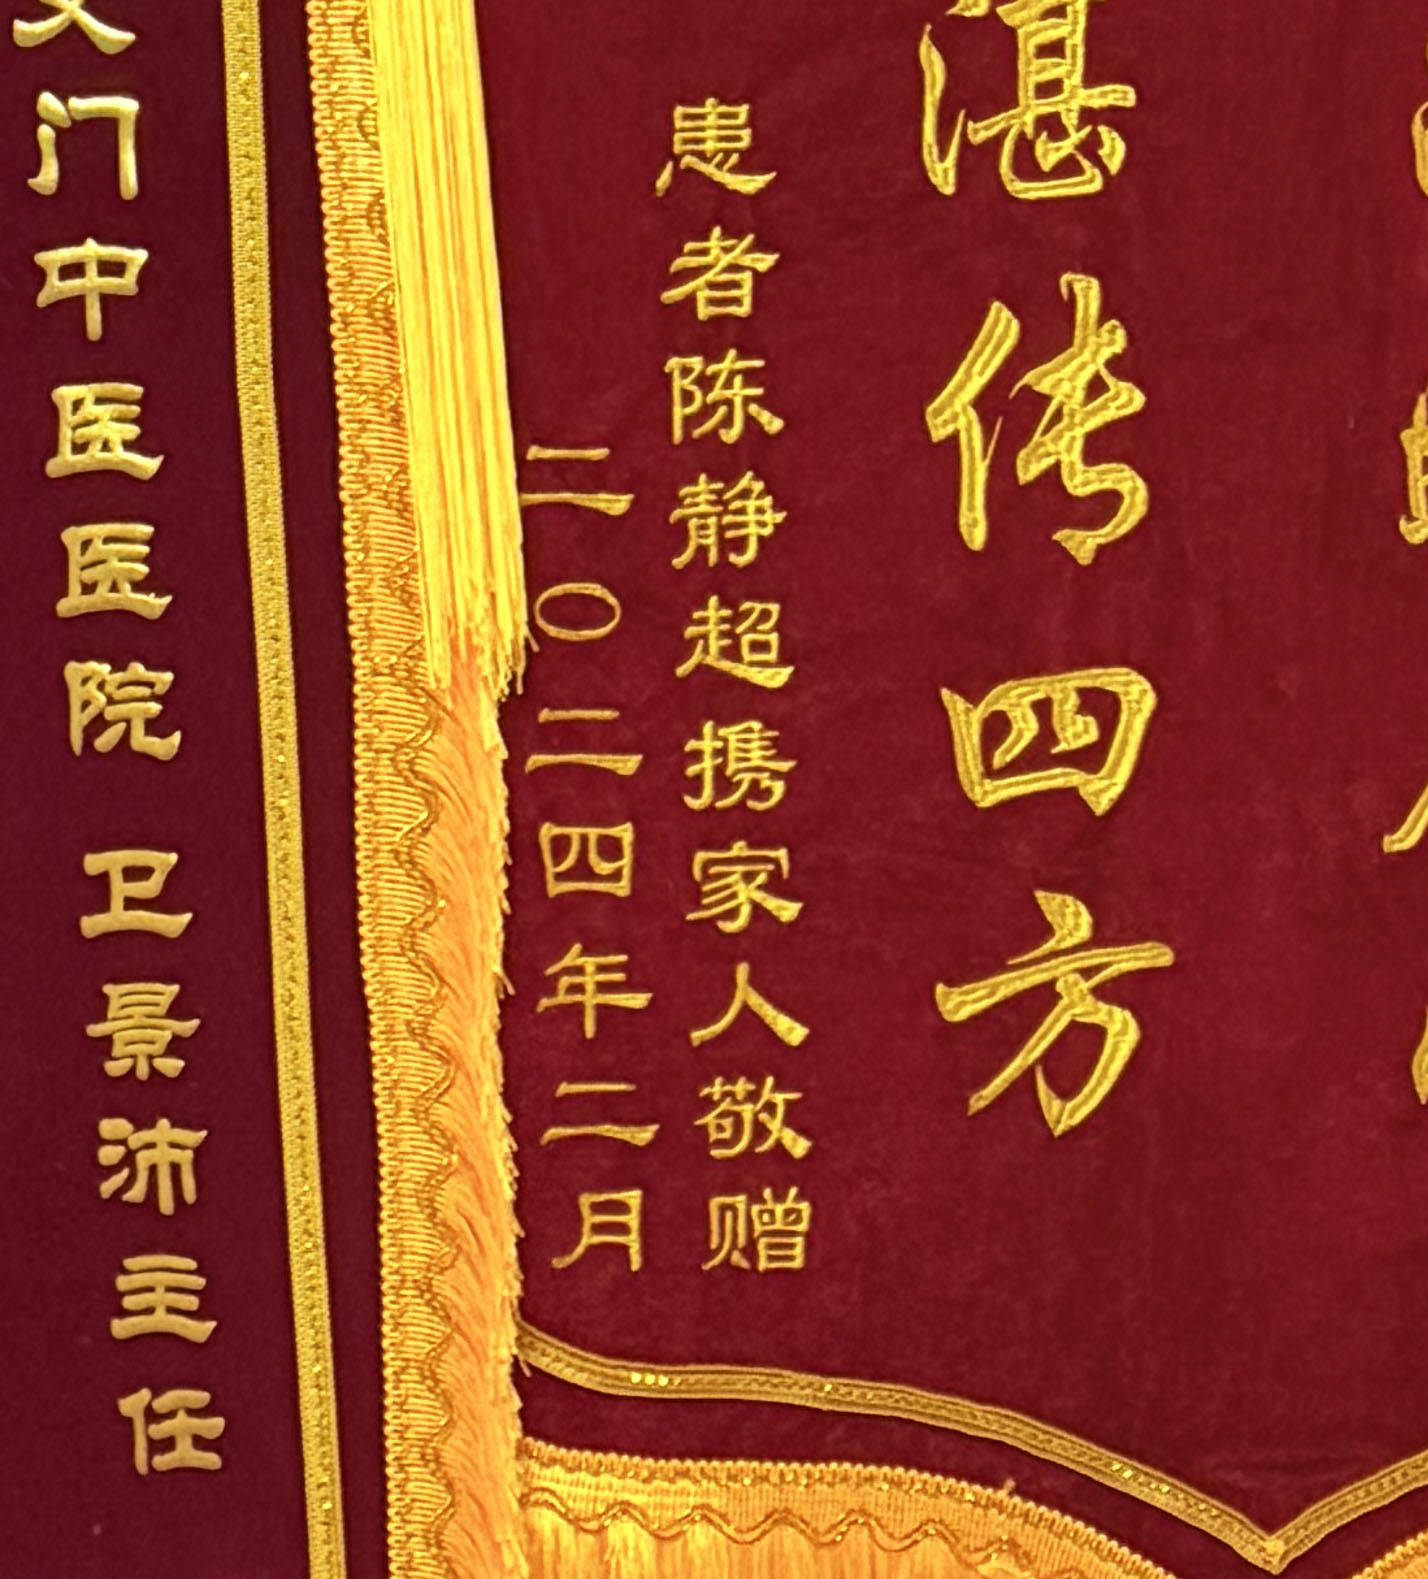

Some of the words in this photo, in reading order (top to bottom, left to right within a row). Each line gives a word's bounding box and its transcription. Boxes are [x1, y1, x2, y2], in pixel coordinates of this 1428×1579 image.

[656, 98, 811, 1270] 患者陈静超携家人敬赠
[919, 0, 1174, 1136] 湛传四方
[81, 850, 225, 1473] 卫景沛主任
